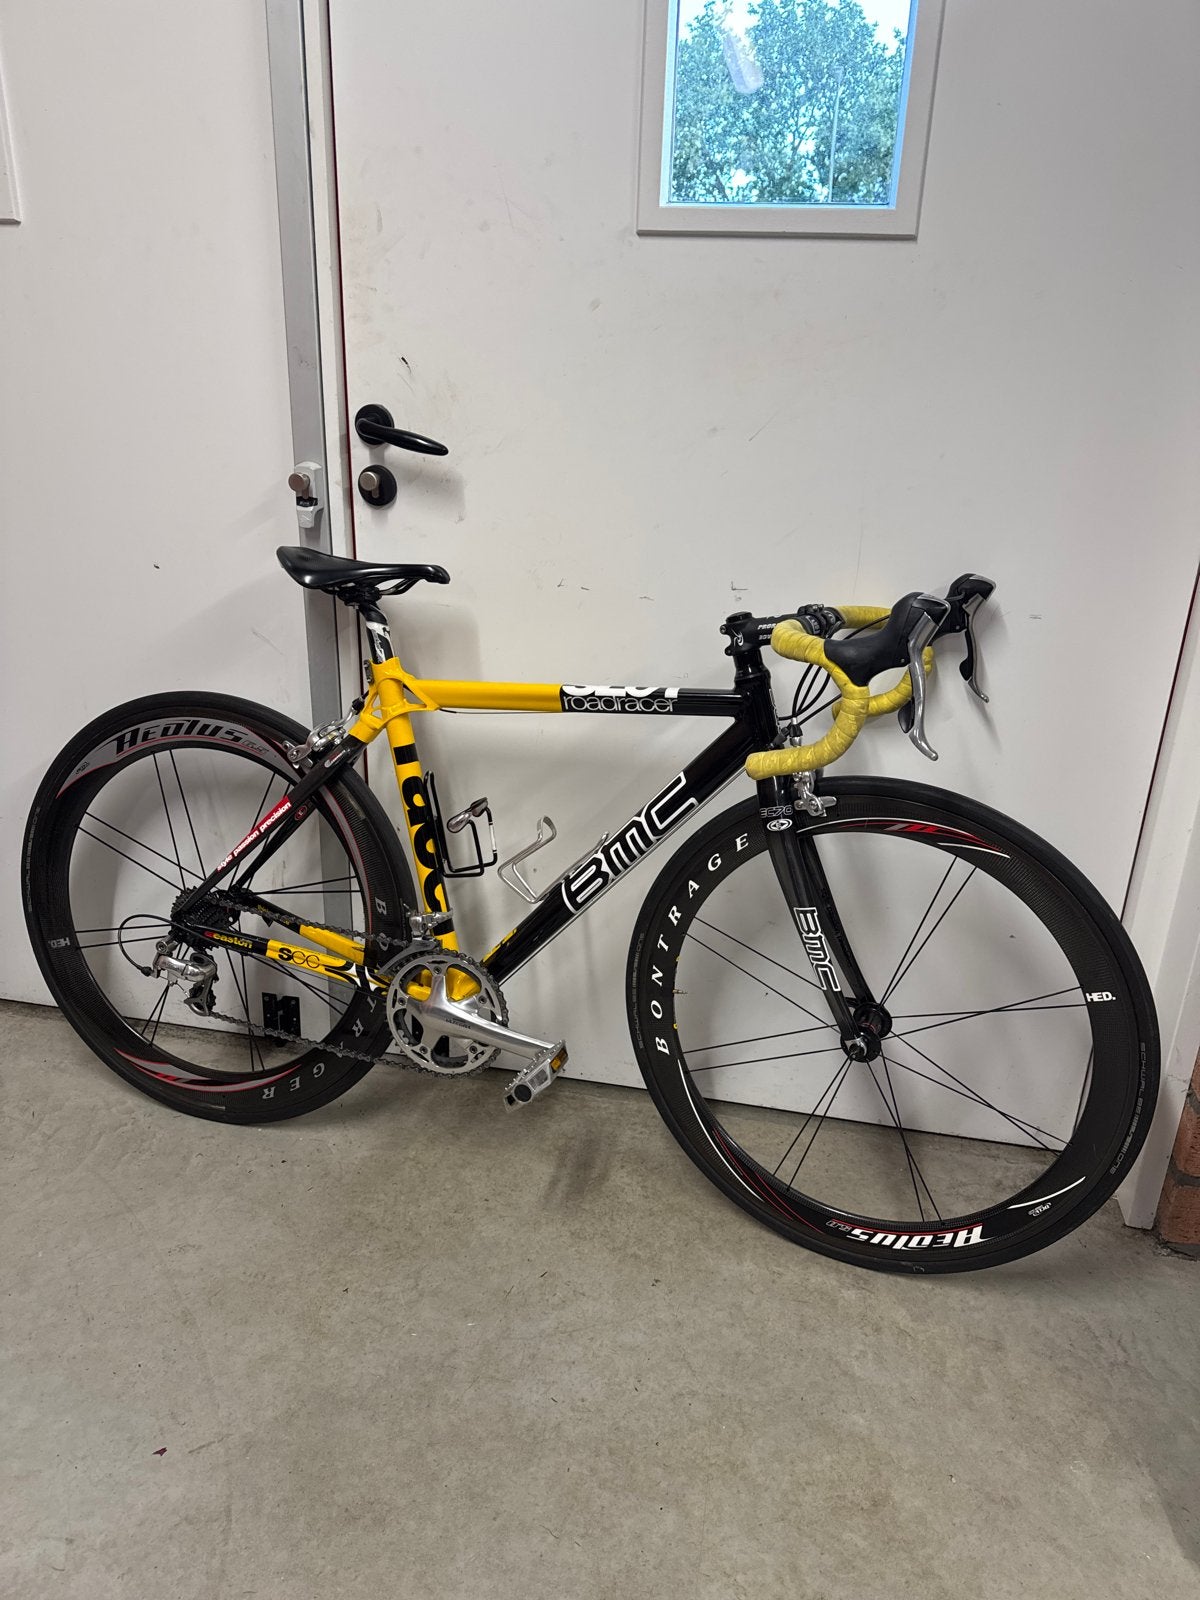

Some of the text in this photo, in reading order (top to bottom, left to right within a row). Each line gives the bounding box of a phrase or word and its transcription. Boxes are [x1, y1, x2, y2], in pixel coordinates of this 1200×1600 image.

[563, 695, 678, 713] roadracer
[217, 801, 292, 872] style passion precision
[561, 771, 699, 915] BMC
[650, 832, 750, 1056] BONTRAGE
[793, 907, 842, 992] BMC
[1085, 991, 1117, 1003] HED.
